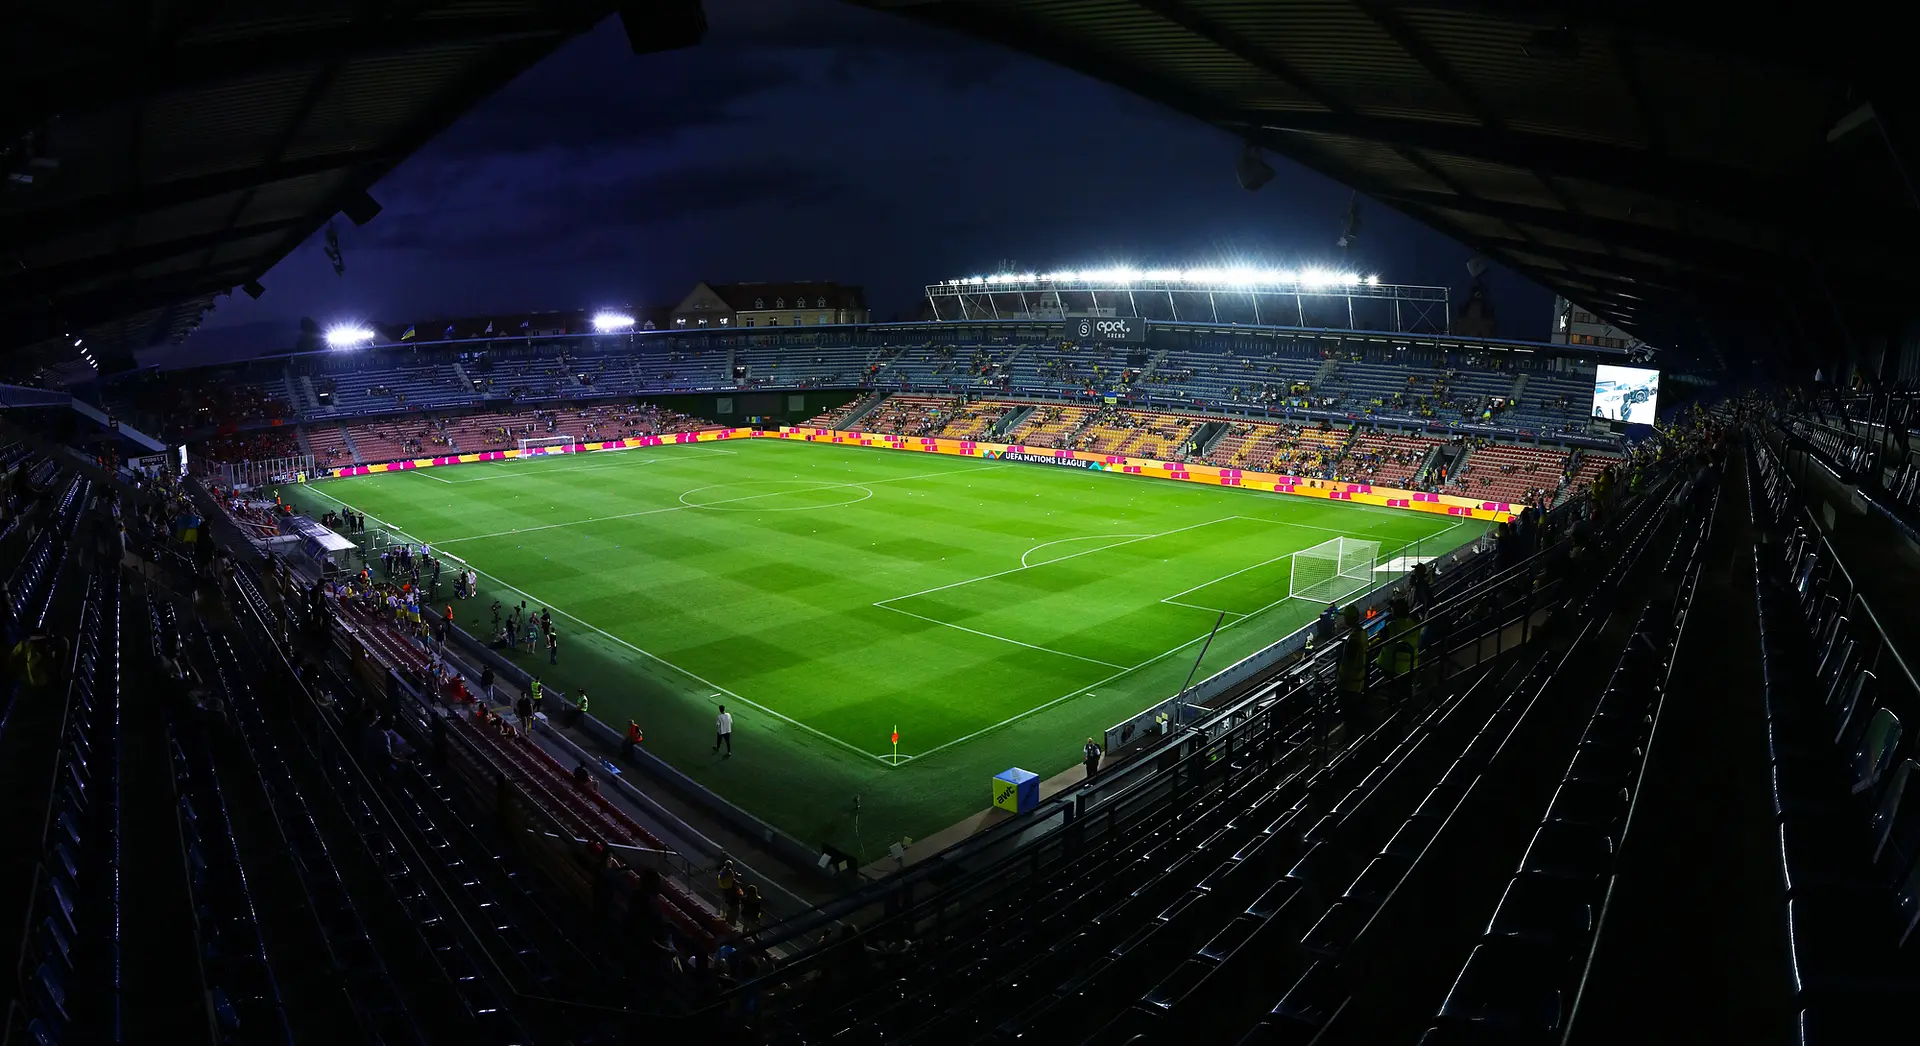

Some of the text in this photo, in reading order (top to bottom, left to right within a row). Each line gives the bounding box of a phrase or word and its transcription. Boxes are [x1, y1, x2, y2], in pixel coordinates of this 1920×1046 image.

[1081, 325, 1088, 334] S
[1005, 452, 1087, 468] UEFA NATIONS LEAGUE
[997, 786, 1015, 804] awt
